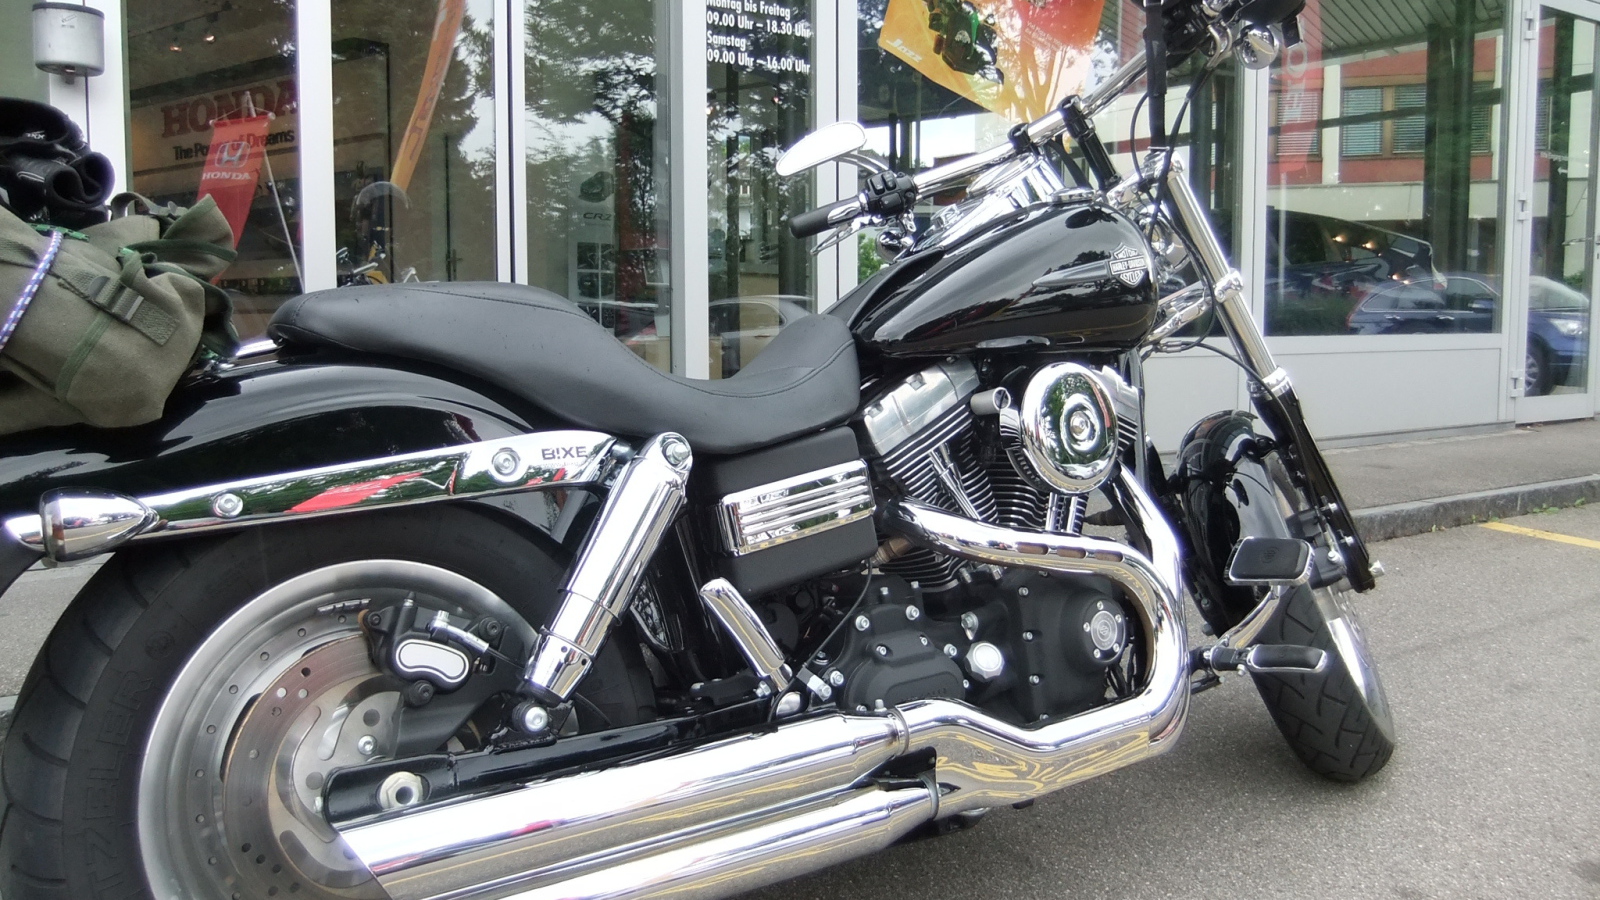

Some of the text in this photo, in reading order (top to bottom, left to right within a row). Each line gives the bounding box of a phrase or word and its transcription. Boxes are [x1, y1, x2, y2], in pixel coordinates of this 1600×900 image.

[744, 0, 758, 13] bis
[760, 1, 791, 21] Freitag
[706, 11, 735, 28] 09.00
[737, 15, 754, 30] Uhr
[766, 19, 792, 35] 18.30
[795, 23, 811, 38] Uhr
[706, 30, 746, 51] Samstag
[885, 38, 923, 63] Jazz
[707, 49, 736, 64] 09.00
[738, 52, 755, 67] Uhr
[766, 55, 793, 71] 16.00
[795, 59, 811, 74] Uhr
[160, 80, 298, 138] HONDA
[173, 145, 193, 160] The
[246, 129, 295, 148] Dreams
[202, 171, 252, 181] HONDA
